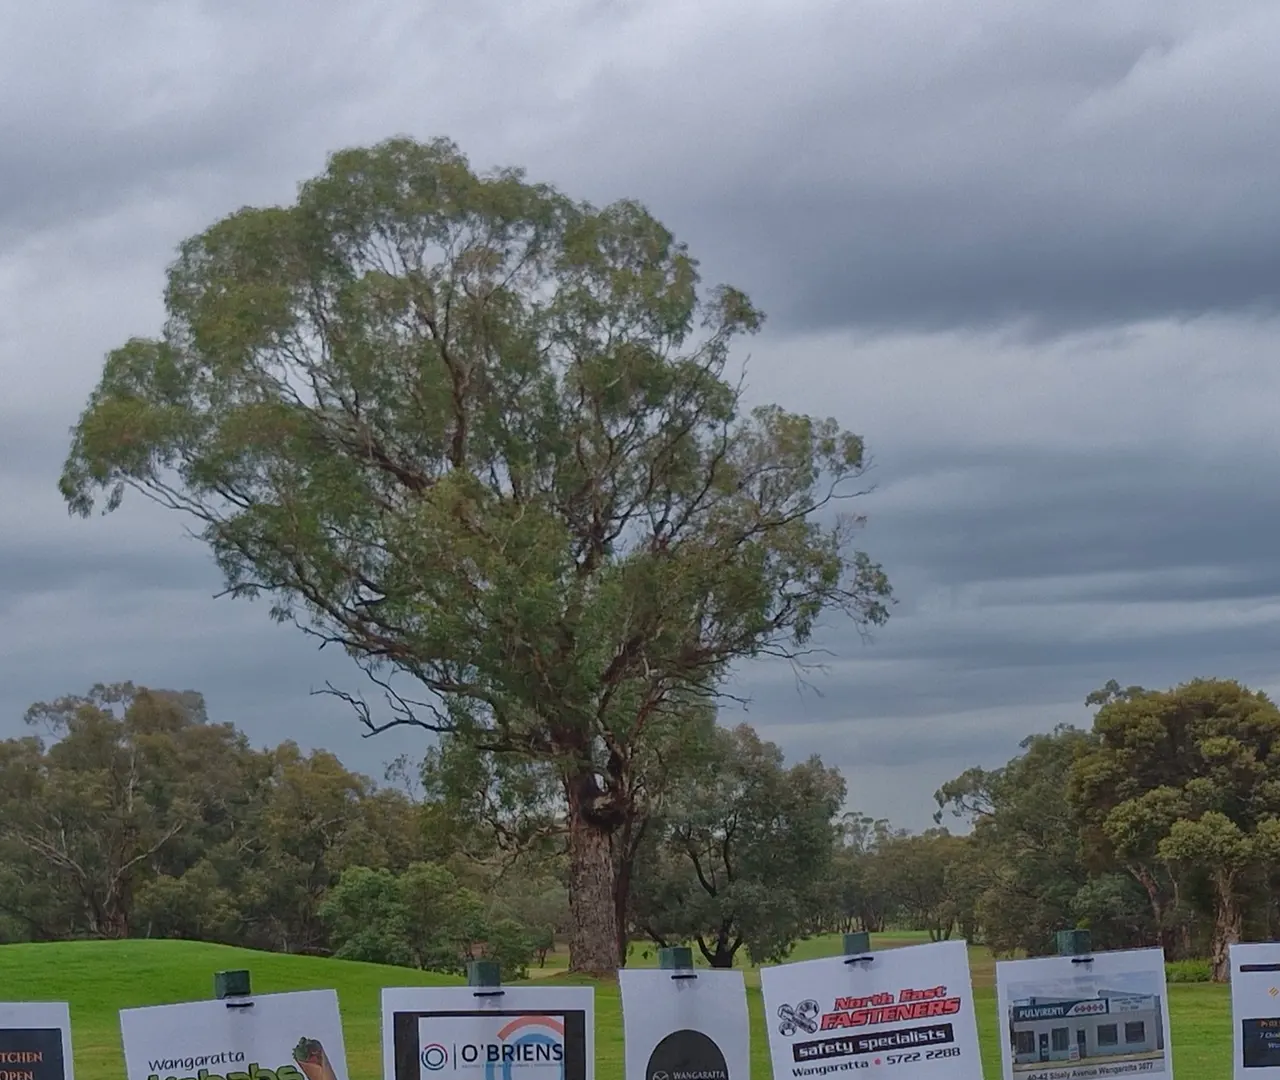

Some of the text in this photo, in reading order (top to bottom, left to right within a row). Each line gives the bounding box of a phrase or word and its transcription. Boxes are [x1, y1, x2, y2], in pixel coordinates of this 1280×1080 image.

[833, 985, 947, 1012] North East
[820, 997, 961, 1032] FASTENERS
[461, 1043, 564, 1063] O'BRIENS
[799, 1029, 946, 1058] safety specialists
[148, 1051, 245, 1072] Wangaratta
[792, 1047, 961, 1078] Wangaratta 5722 2288
[1072, 1069, 1097, 1078] Avenue
[1099, 1064, 1138, 1076] Wangaratta
[673, 1071, 726, 1080] WANGARATTA
